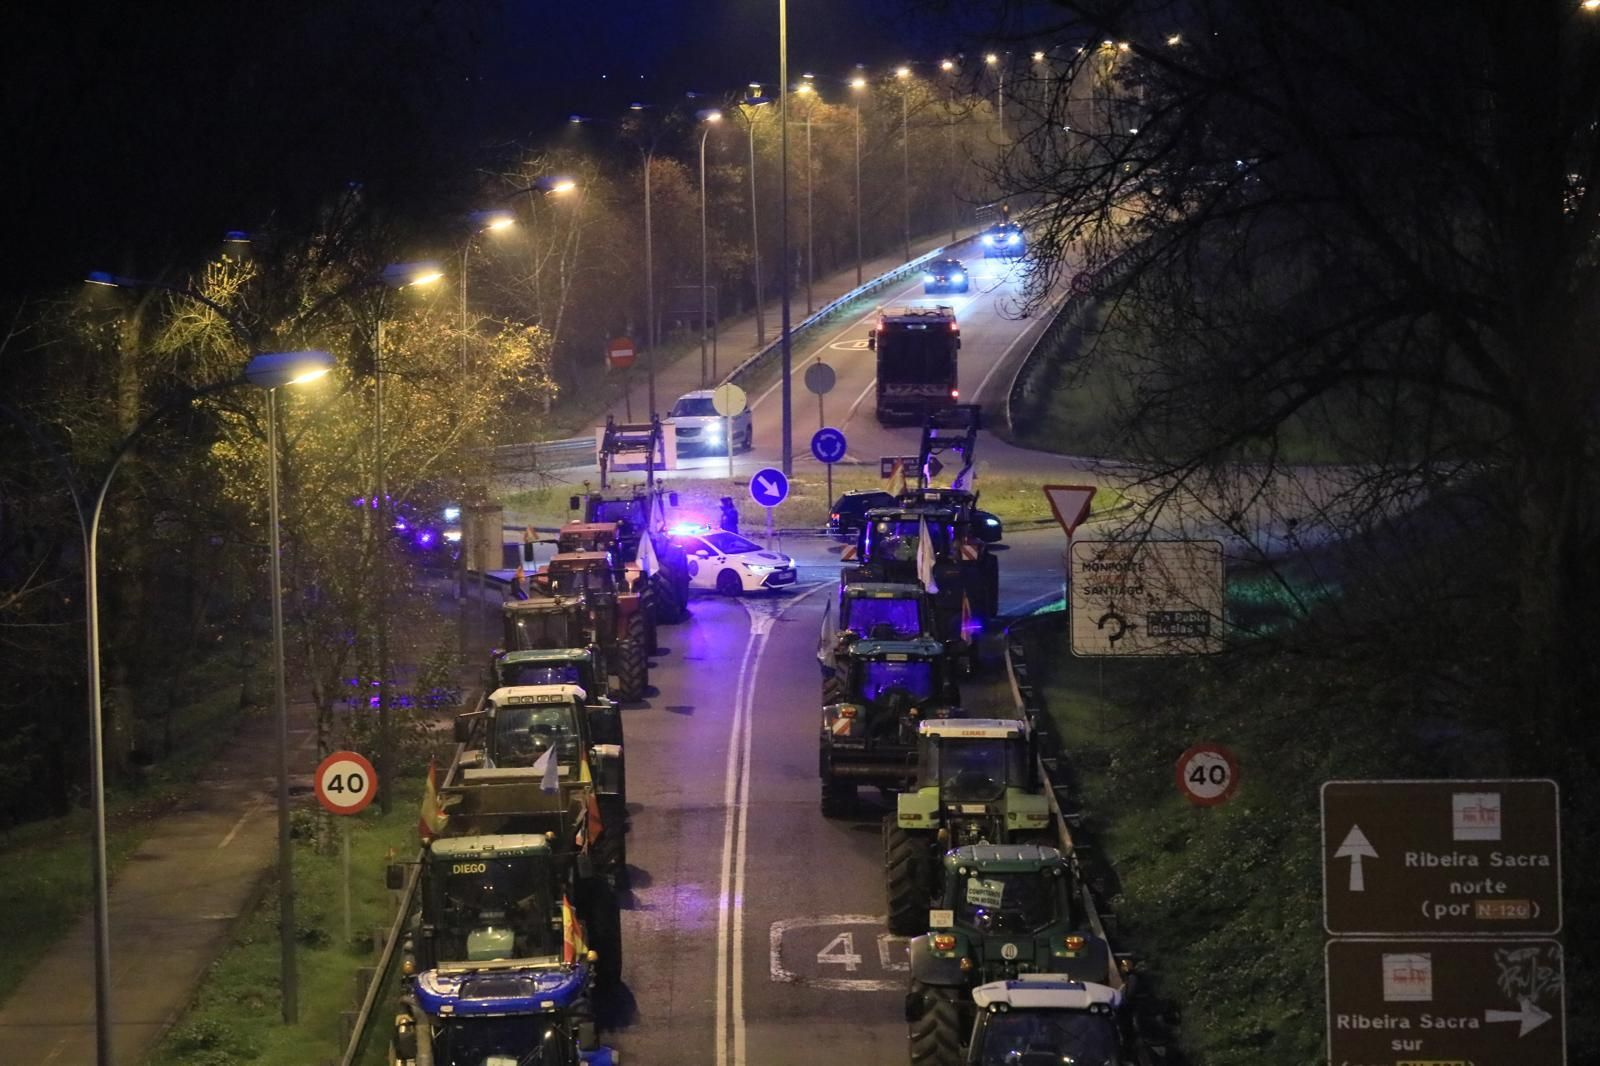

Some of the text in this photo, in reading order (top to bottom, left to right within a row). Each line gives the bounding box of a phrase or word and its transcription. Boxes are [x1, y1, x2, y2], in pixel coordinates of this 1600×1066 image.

[1084, 586, 1143, 595] SANTIAGO
[327, 773, 364, 793] 40
[1189, 765, 1225, 785] 40
[1405, 852, 1550, 867] Ribeira Sacra
[453, 863, 486, 874] DIEGO
[1450, 878, 1507, 894] norte
[1422, 900, 1470, 919] (por
[1337, 1013, 1480, 1029] Ribeira Sacra
[1391, 1039, 1424, 1051] sur
